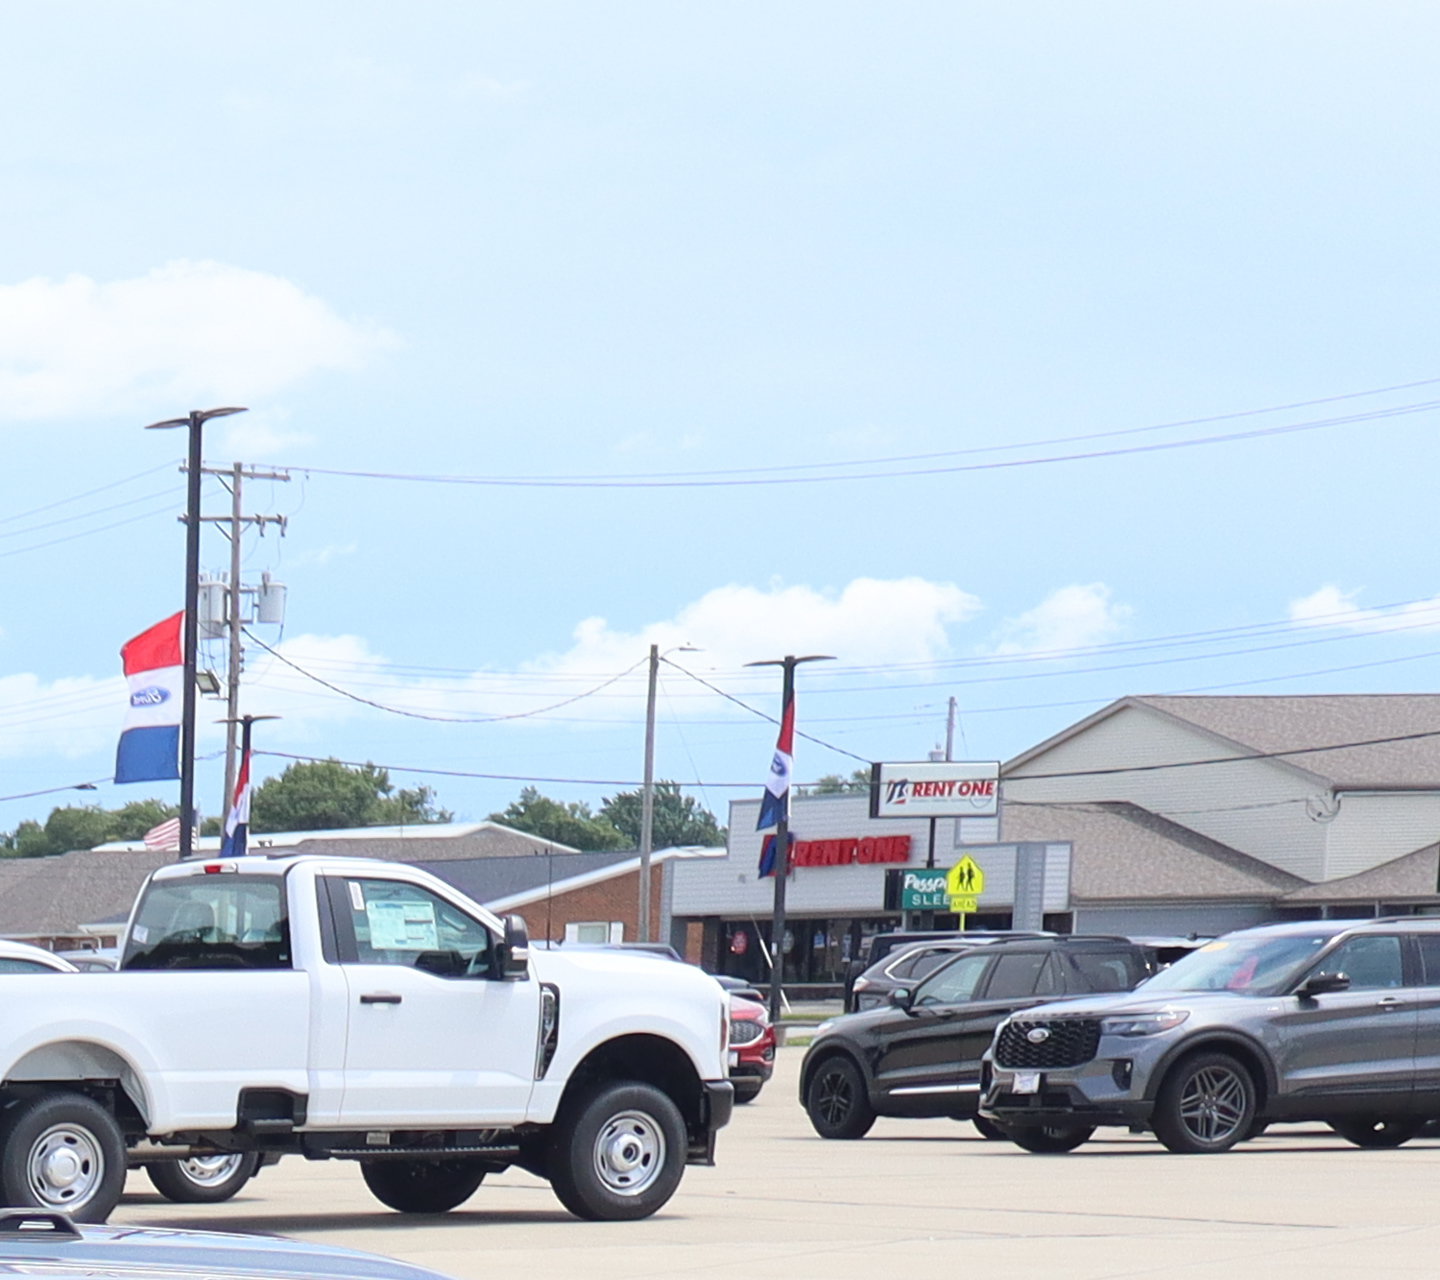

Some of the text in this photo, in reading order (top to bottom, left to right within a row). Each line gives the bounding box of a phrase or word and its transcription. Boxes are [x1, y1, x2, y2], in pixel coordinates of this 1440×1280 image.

[912, 780, 995, 797] RENT ONE
[793, 834, 912, 868] RENT ONE
[903, 873, 947, 893] Passp
[911, 893, 950, 906] SLEE
